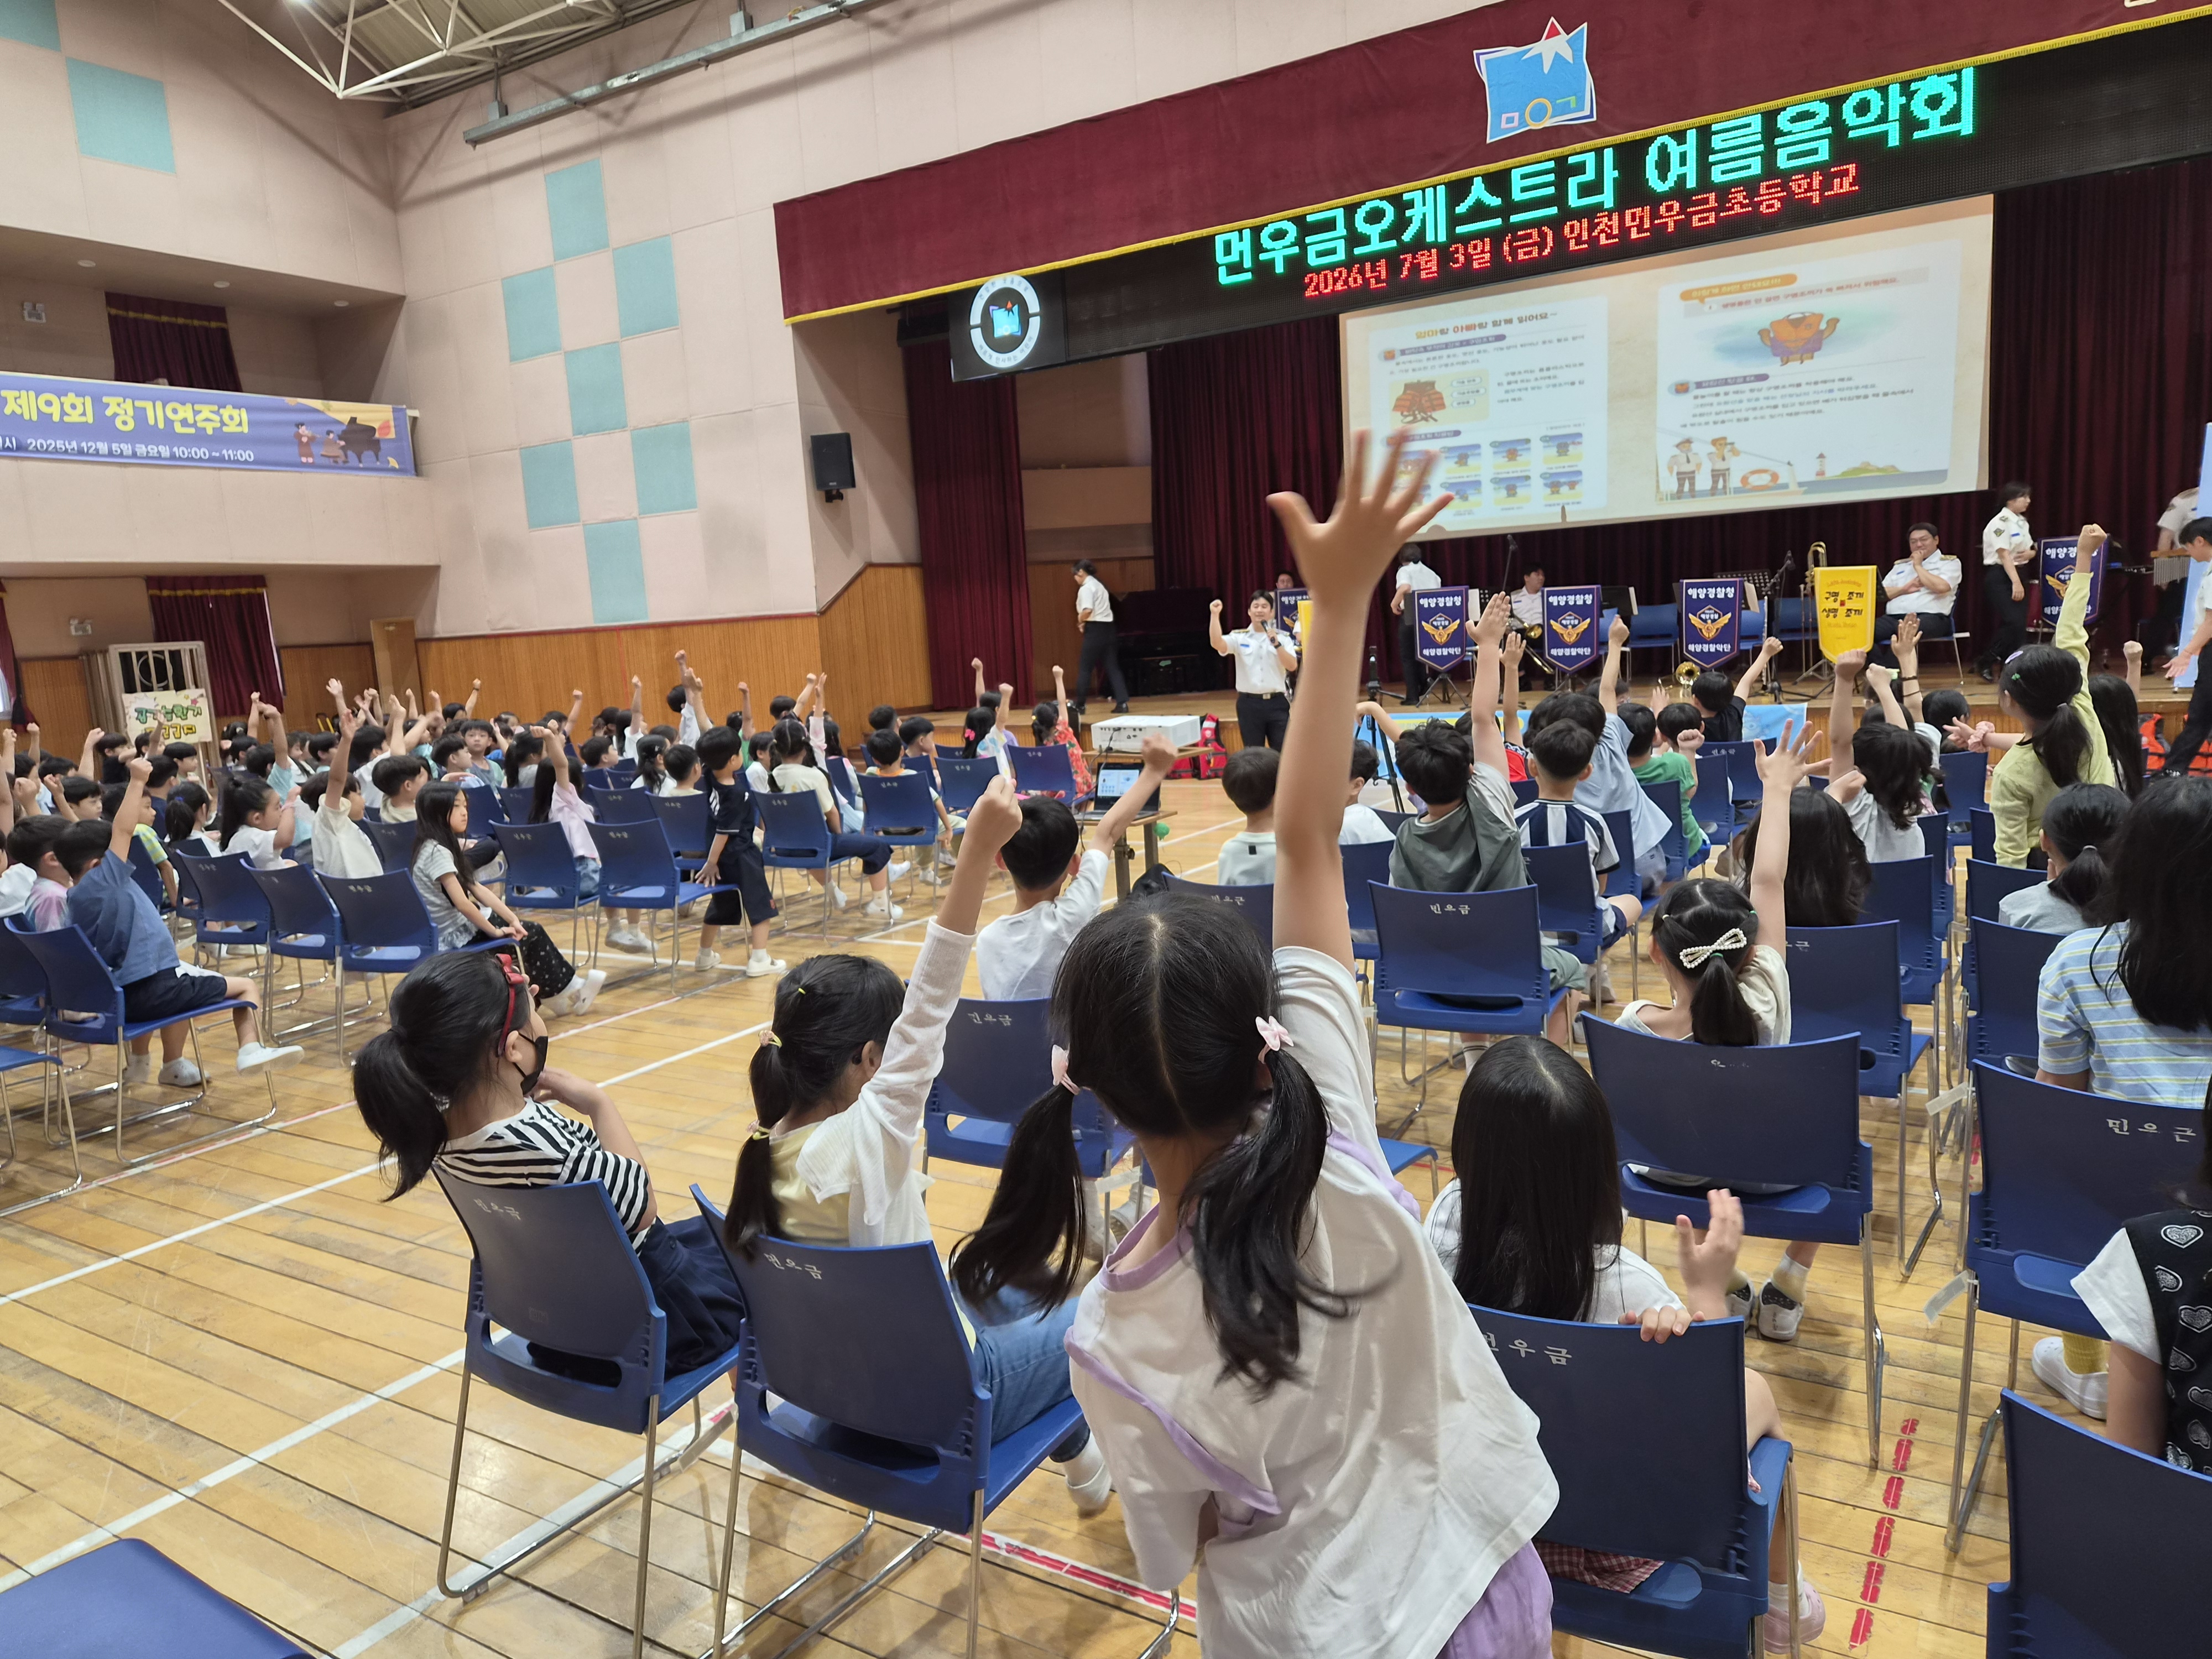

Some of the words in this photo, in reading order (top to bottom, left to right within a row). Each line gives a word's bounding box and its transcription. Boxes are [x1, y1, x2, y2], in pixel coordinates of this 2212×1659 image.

[1215, 147, 1618, 285] 먼우금오케스트라
[1646, 66, 1974, 192] 여름음악회
[1304, 258, 1388, 298] 2026년
[1399, 248, 1439, 279] 7월
[1449, 238, 1490, 270] 3일
[1503, 226, 1553, 262] (금)
[1564, 163, 1859, 251] 인천먼우금초등학교
[1453, 321, 1488, 333] 아빠랑
[1, 389, 93, 424] 제9회
[102, 395, 249, 435] 정기연주회
[0, 435, 17, 451] 시
[27, 437, 78, 454] 2025년
[81, 441, 109, 456] 12월
[112, 442, 133, 457] 5일
[135, 444, 170, 458] 금요일
[172, 446, 209, 460] 10:00
[222, 448, 254, 462] 11:00
[1687, 587, 1735, 599] 해양경찰청
[1824, 591, 1840, 603] 구명
[1846, 591, 1864, 600] 조끼
[1420, 596, 1462, 608] 해양경찰청
[1548, 593, 1593, 606] 해양경찰청
[1822, 608, 1839, 619] 생명
[1845, 608, 1863, 618] 조끼
